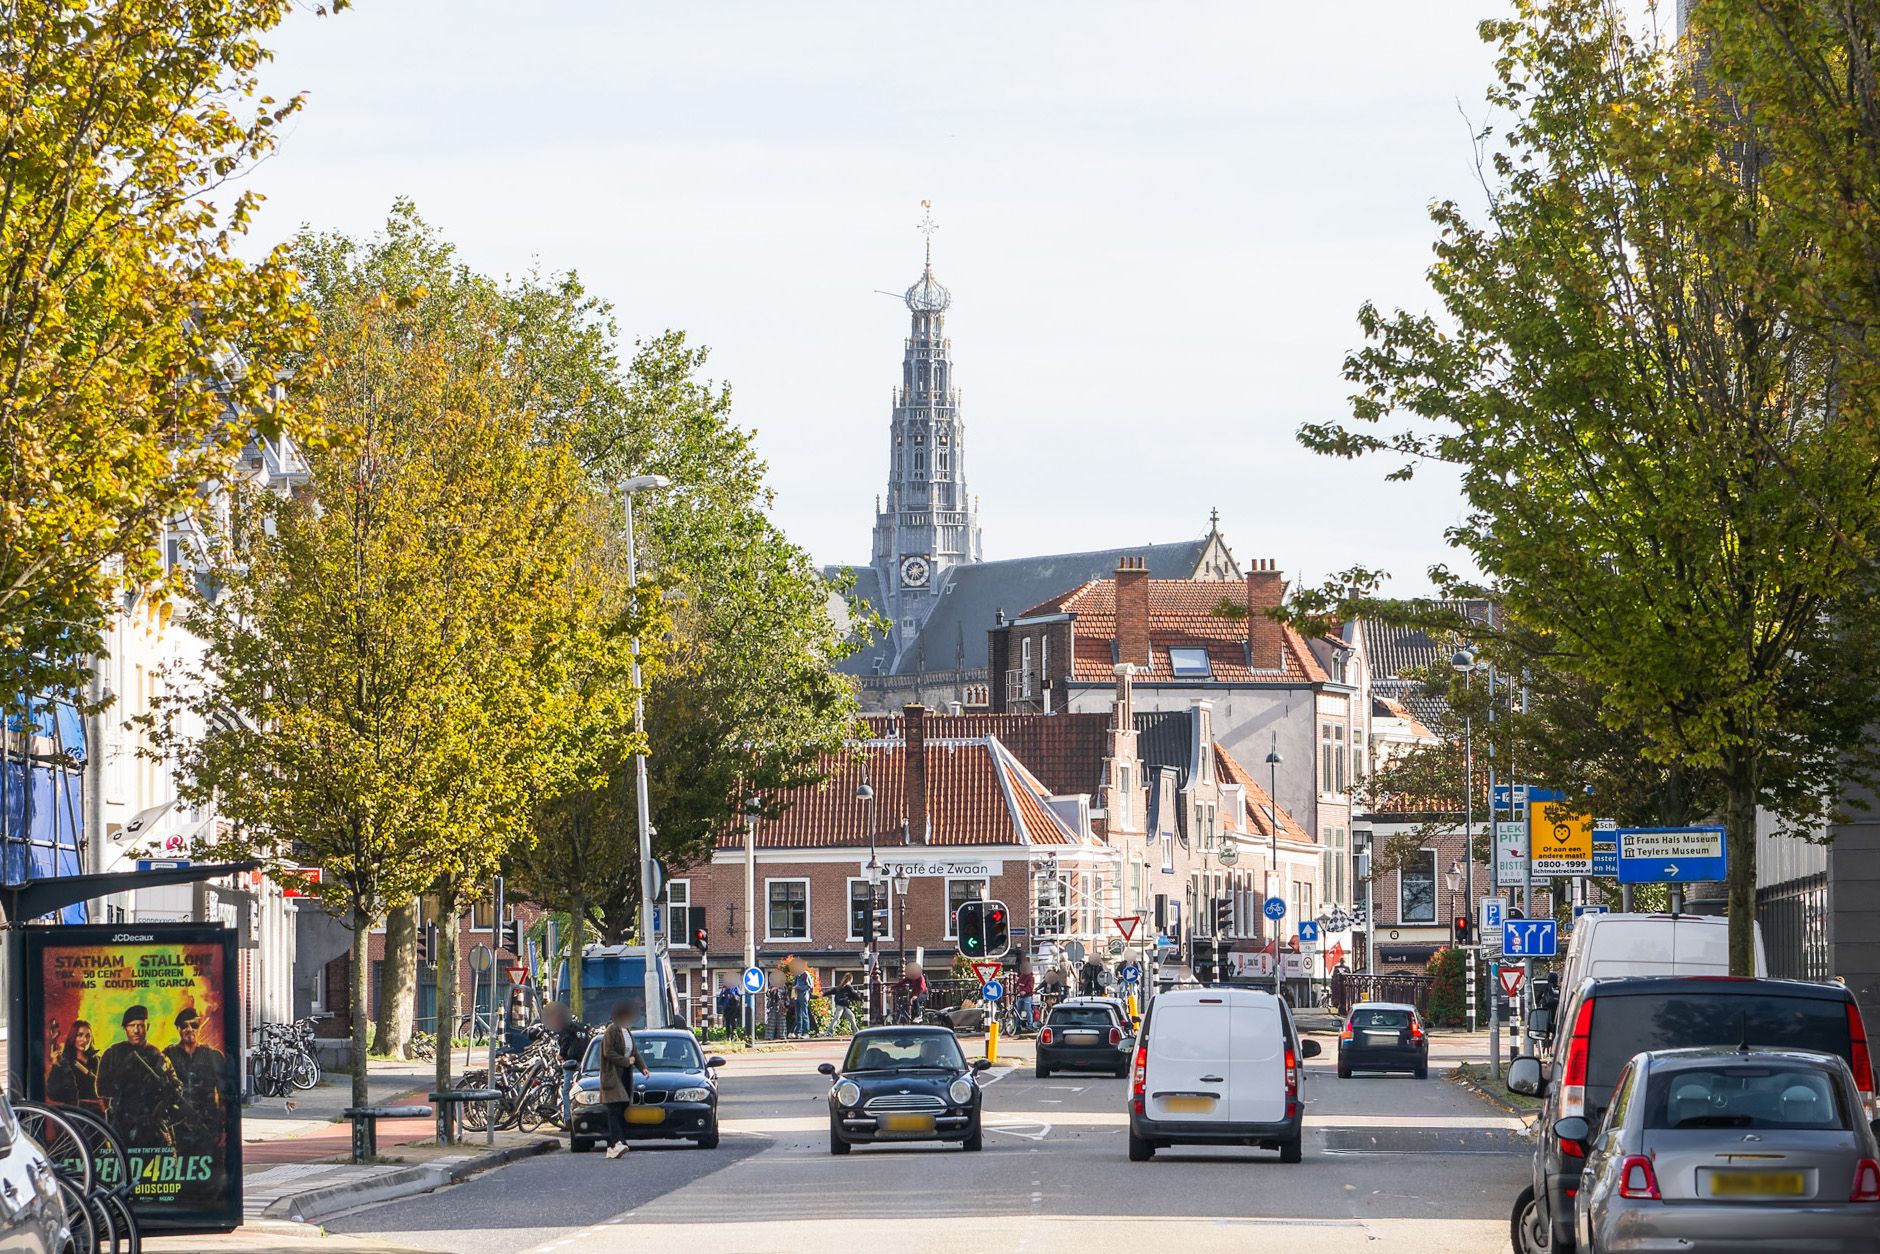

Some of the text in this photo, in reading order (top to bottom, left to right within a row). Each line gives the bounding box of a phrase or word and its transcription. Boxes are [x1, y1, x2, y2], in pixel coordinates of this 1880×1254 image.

[1500, 834, 1524, 842] PIT
[1636, 836, 1660, 844] Frans
[1683, 835, 1718, 843] Museum
[1637, 847, 1709, 857] Teylers Museum
[895, 864, 988, 874] Café de Zwaan
[1489, 906, 1498, 917] P
[112, 933, 154, 942] JCDecaux
[55, 953, 213, 968] STATHAM STALLONE
[84, 970, 96, 979] 50
[98, 969, 122, 979] CENT
[131, 969, 184, 978] LUNDGREN
[105, 979, 150, 989] COUTURE
[135, 1184, 182, 1194] BIOSCOOP
